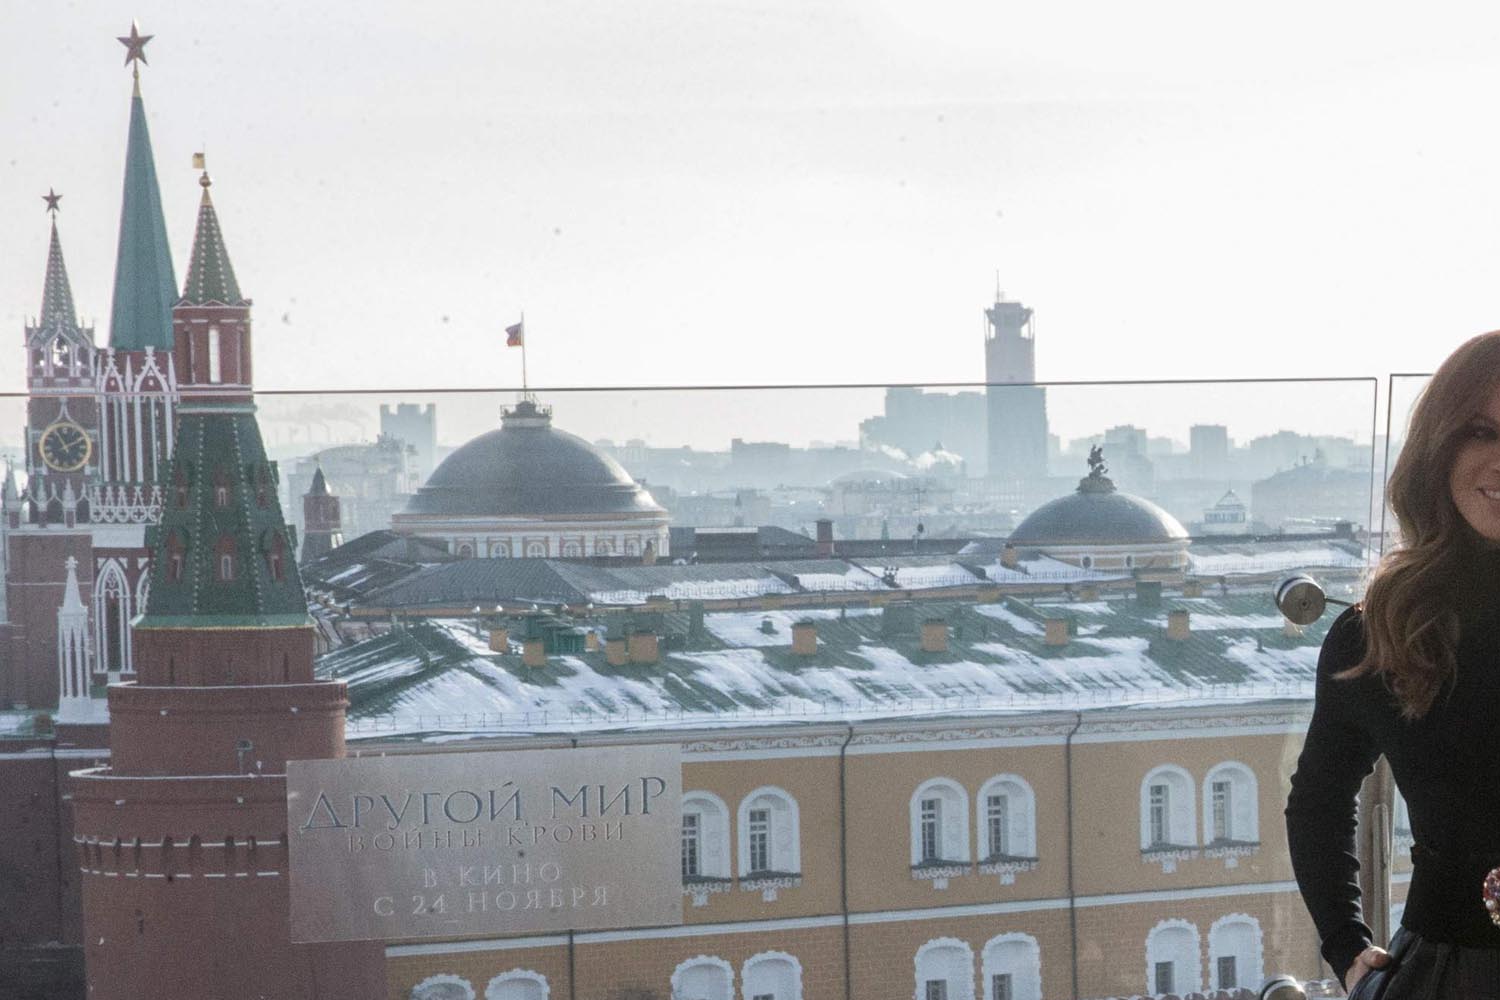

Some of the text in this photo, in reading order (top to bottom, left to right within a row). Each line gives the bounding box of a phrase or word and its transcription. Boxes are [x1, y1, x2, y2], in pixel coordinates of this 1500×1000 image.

[300, 776, 667, 834] ДРУГОЙ МИР
[349, 822, 623, 853] ВОЙНЫ КРОВИ
[423, 863, 561, 889] В КИНО
[373, 885, 609, 917] С 24 НОЯБРЯ
